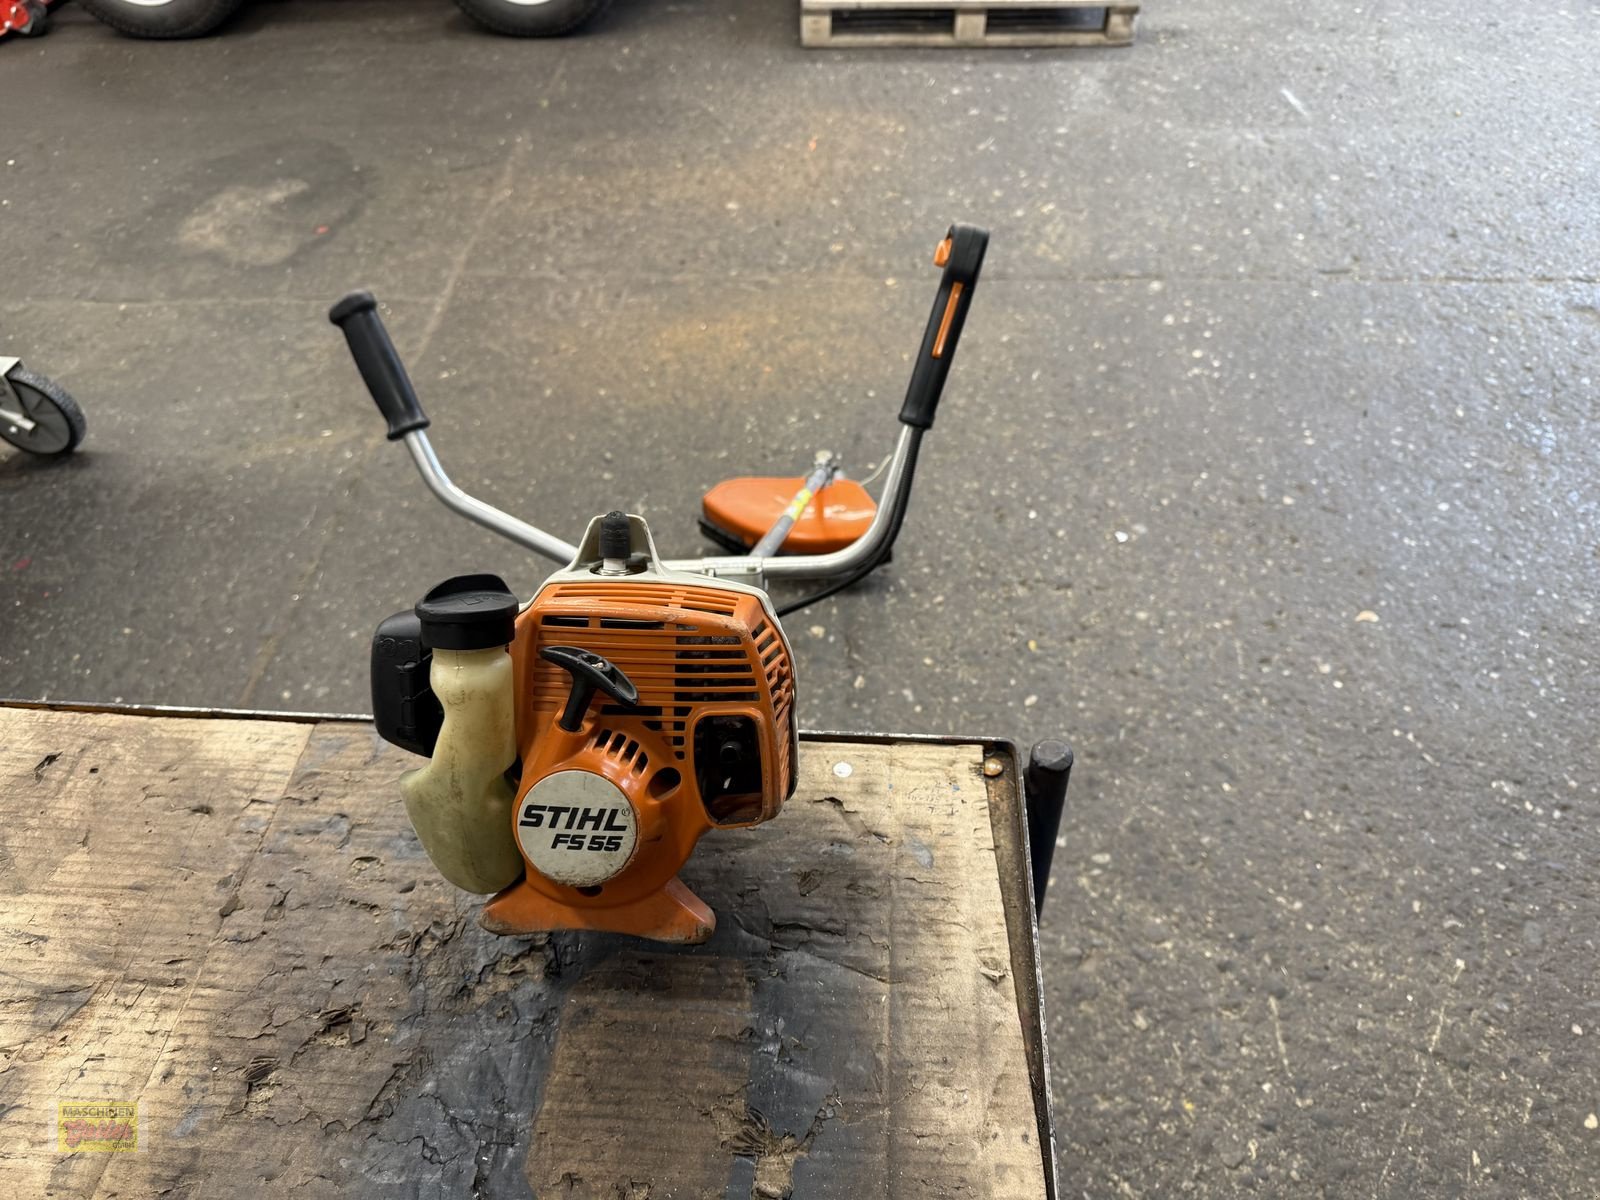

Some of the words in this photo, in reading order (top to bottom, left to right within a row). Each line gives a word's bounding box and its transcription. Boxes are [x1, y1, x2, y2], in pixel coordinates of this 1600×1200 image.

[519, 804, 628, 832] STIHL
[551, 833, 587, 851] FS
[587, 835, 624, 852] 55
